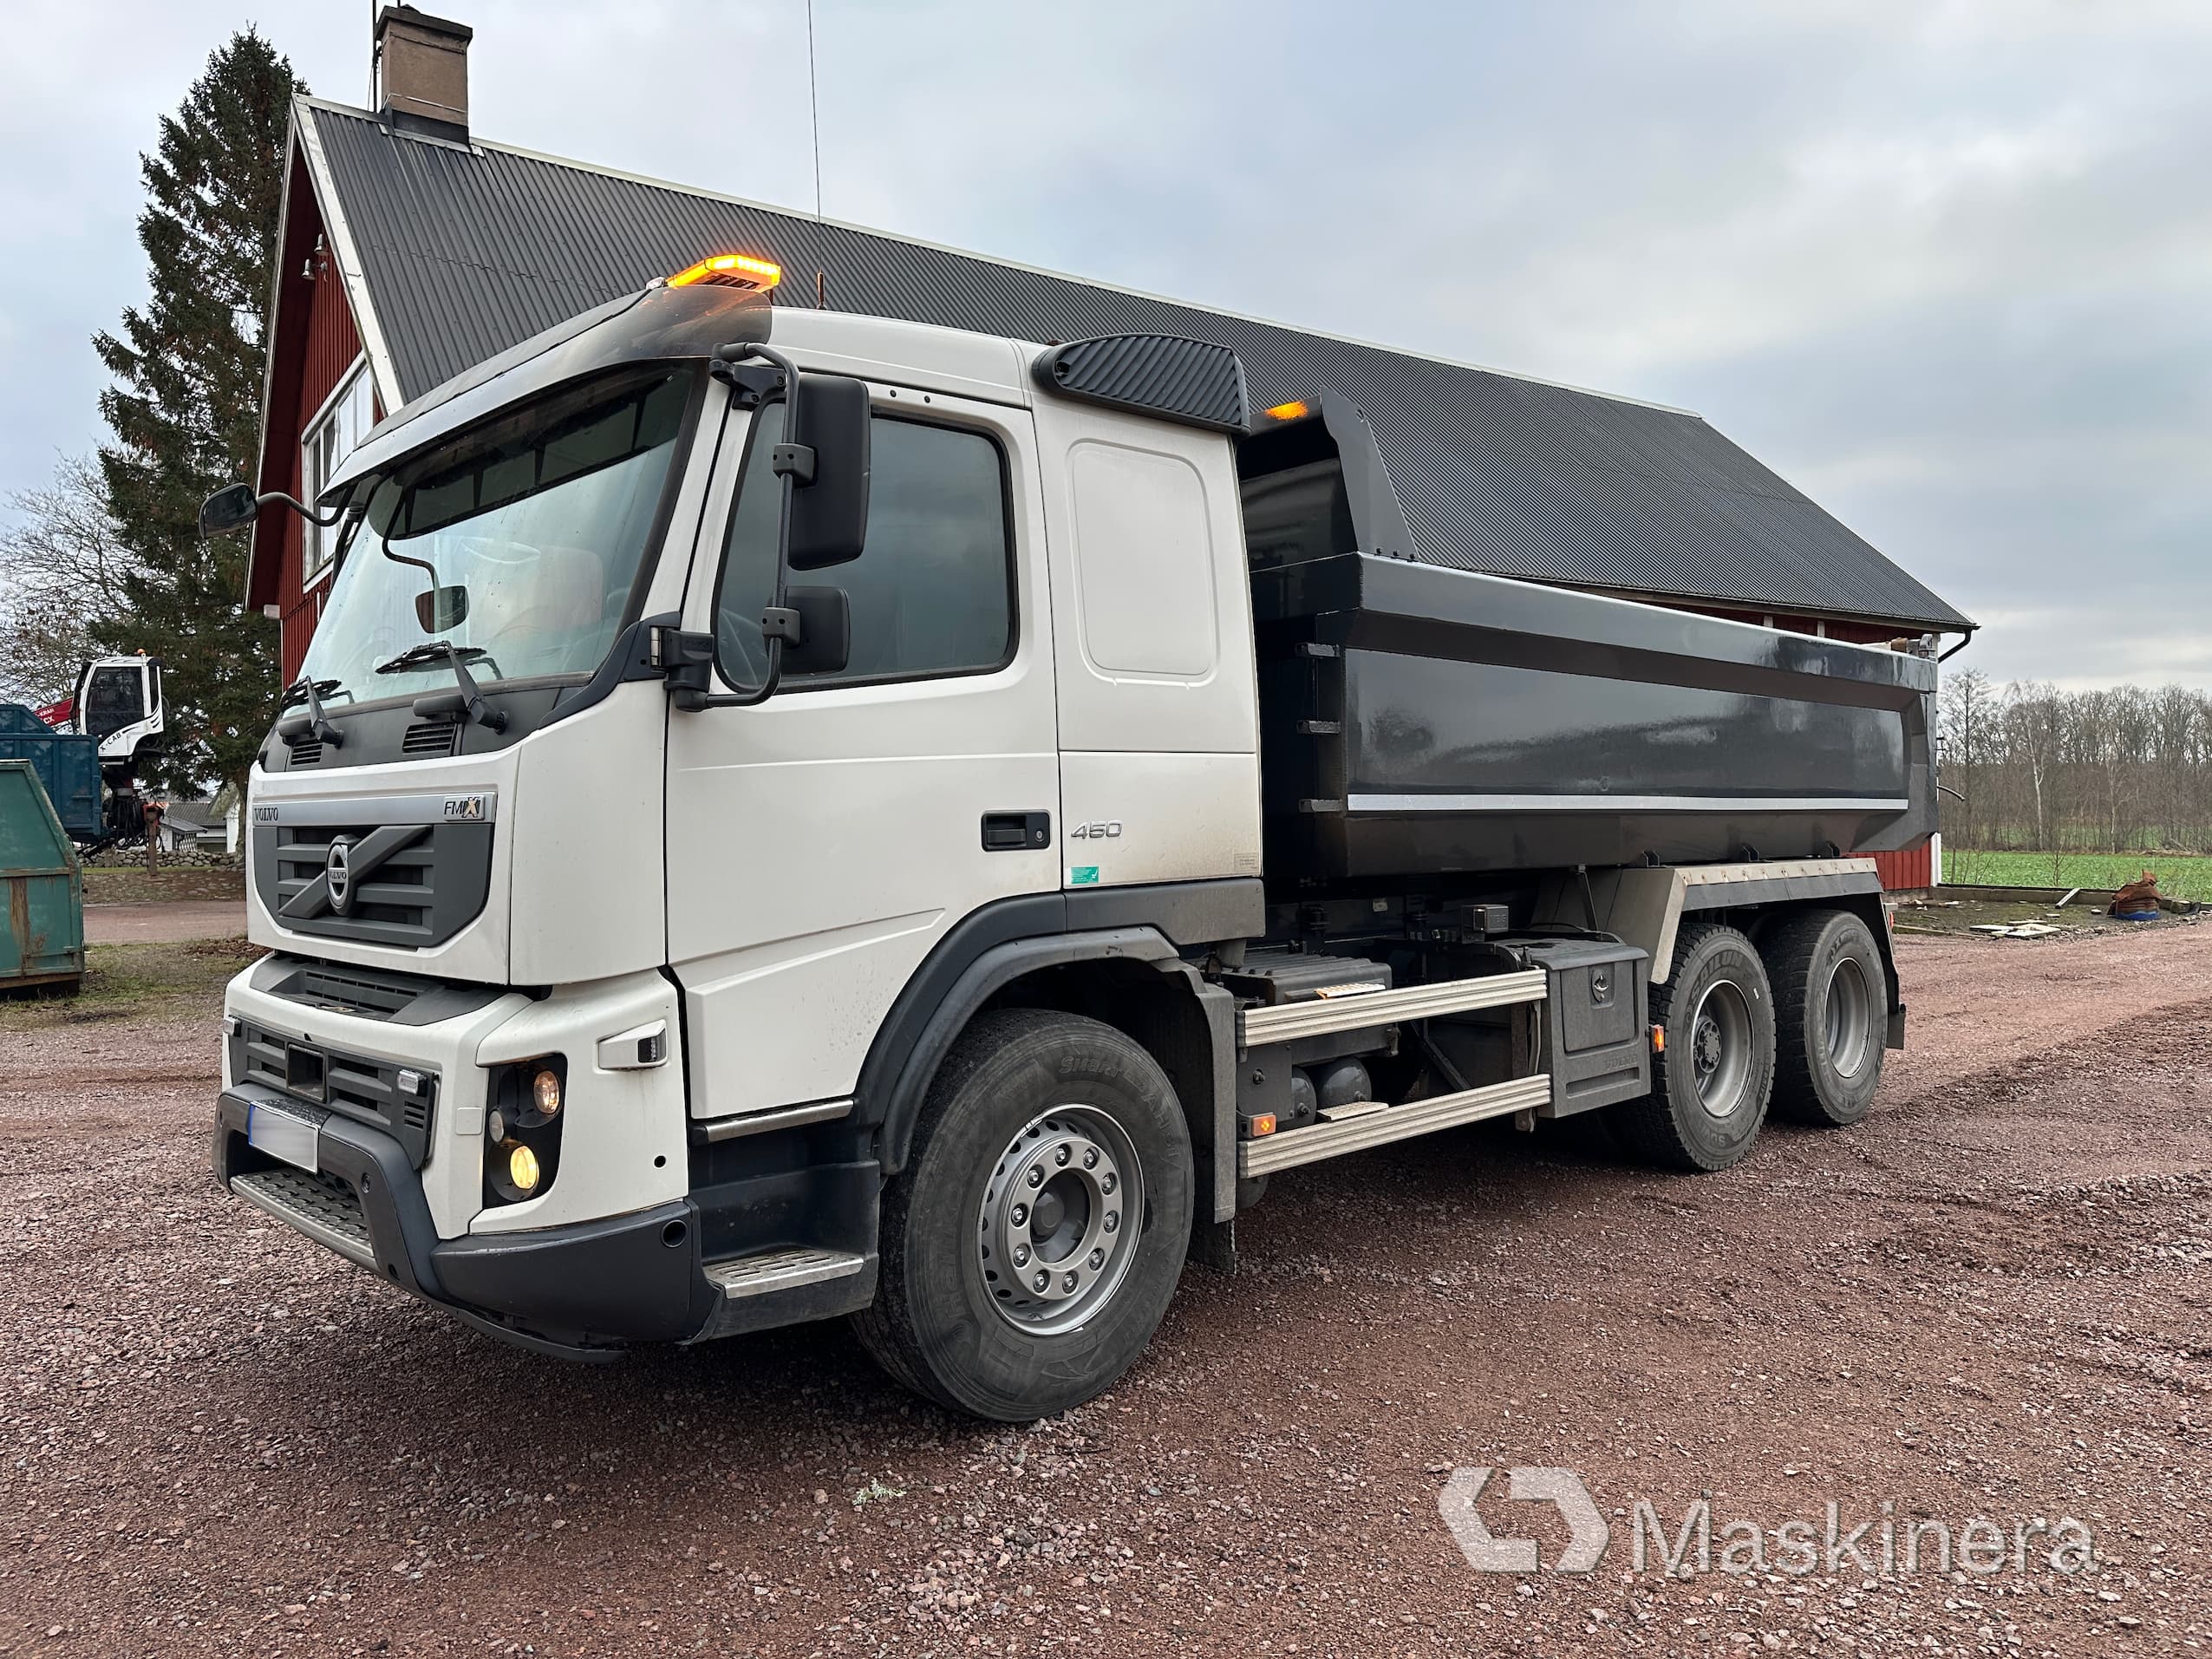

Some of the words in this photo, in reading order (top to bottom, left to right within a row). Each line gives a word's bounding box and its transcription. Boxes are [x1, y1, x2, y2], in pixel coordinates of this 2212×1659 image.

[100, 732, 122, 753] X-CAB
[254, 807, 278, 821] VOLVO
[444, 796, 481, 819] FMX
[1070, 820, 1124, 839] 450
